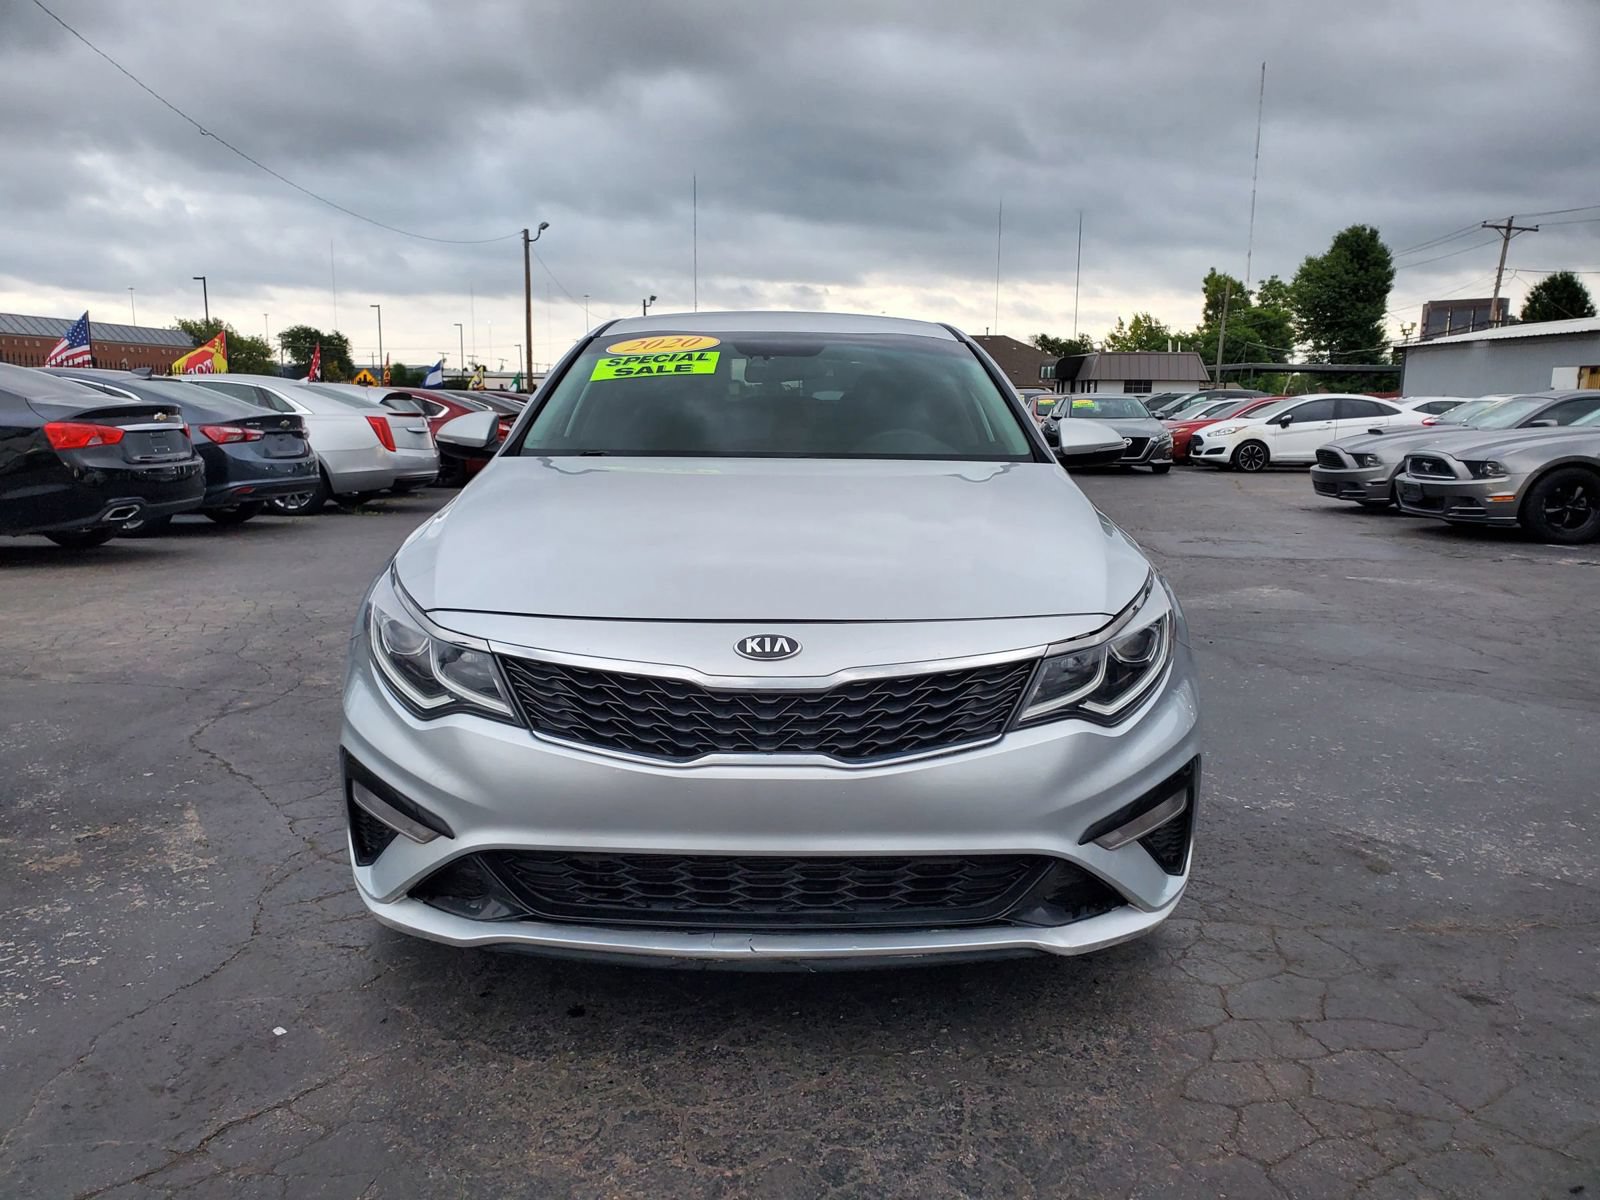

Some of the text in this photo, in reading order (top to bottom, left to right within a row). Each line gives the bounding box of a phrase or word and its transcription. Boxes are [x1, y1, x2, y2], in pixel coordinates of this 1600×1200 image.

[624, 337, 703, 352] 2020
[606, 352, 711, 367] SPECIAL
[613, 363, 694, 376] SALE
[745, 637, 791, 653] KIA
